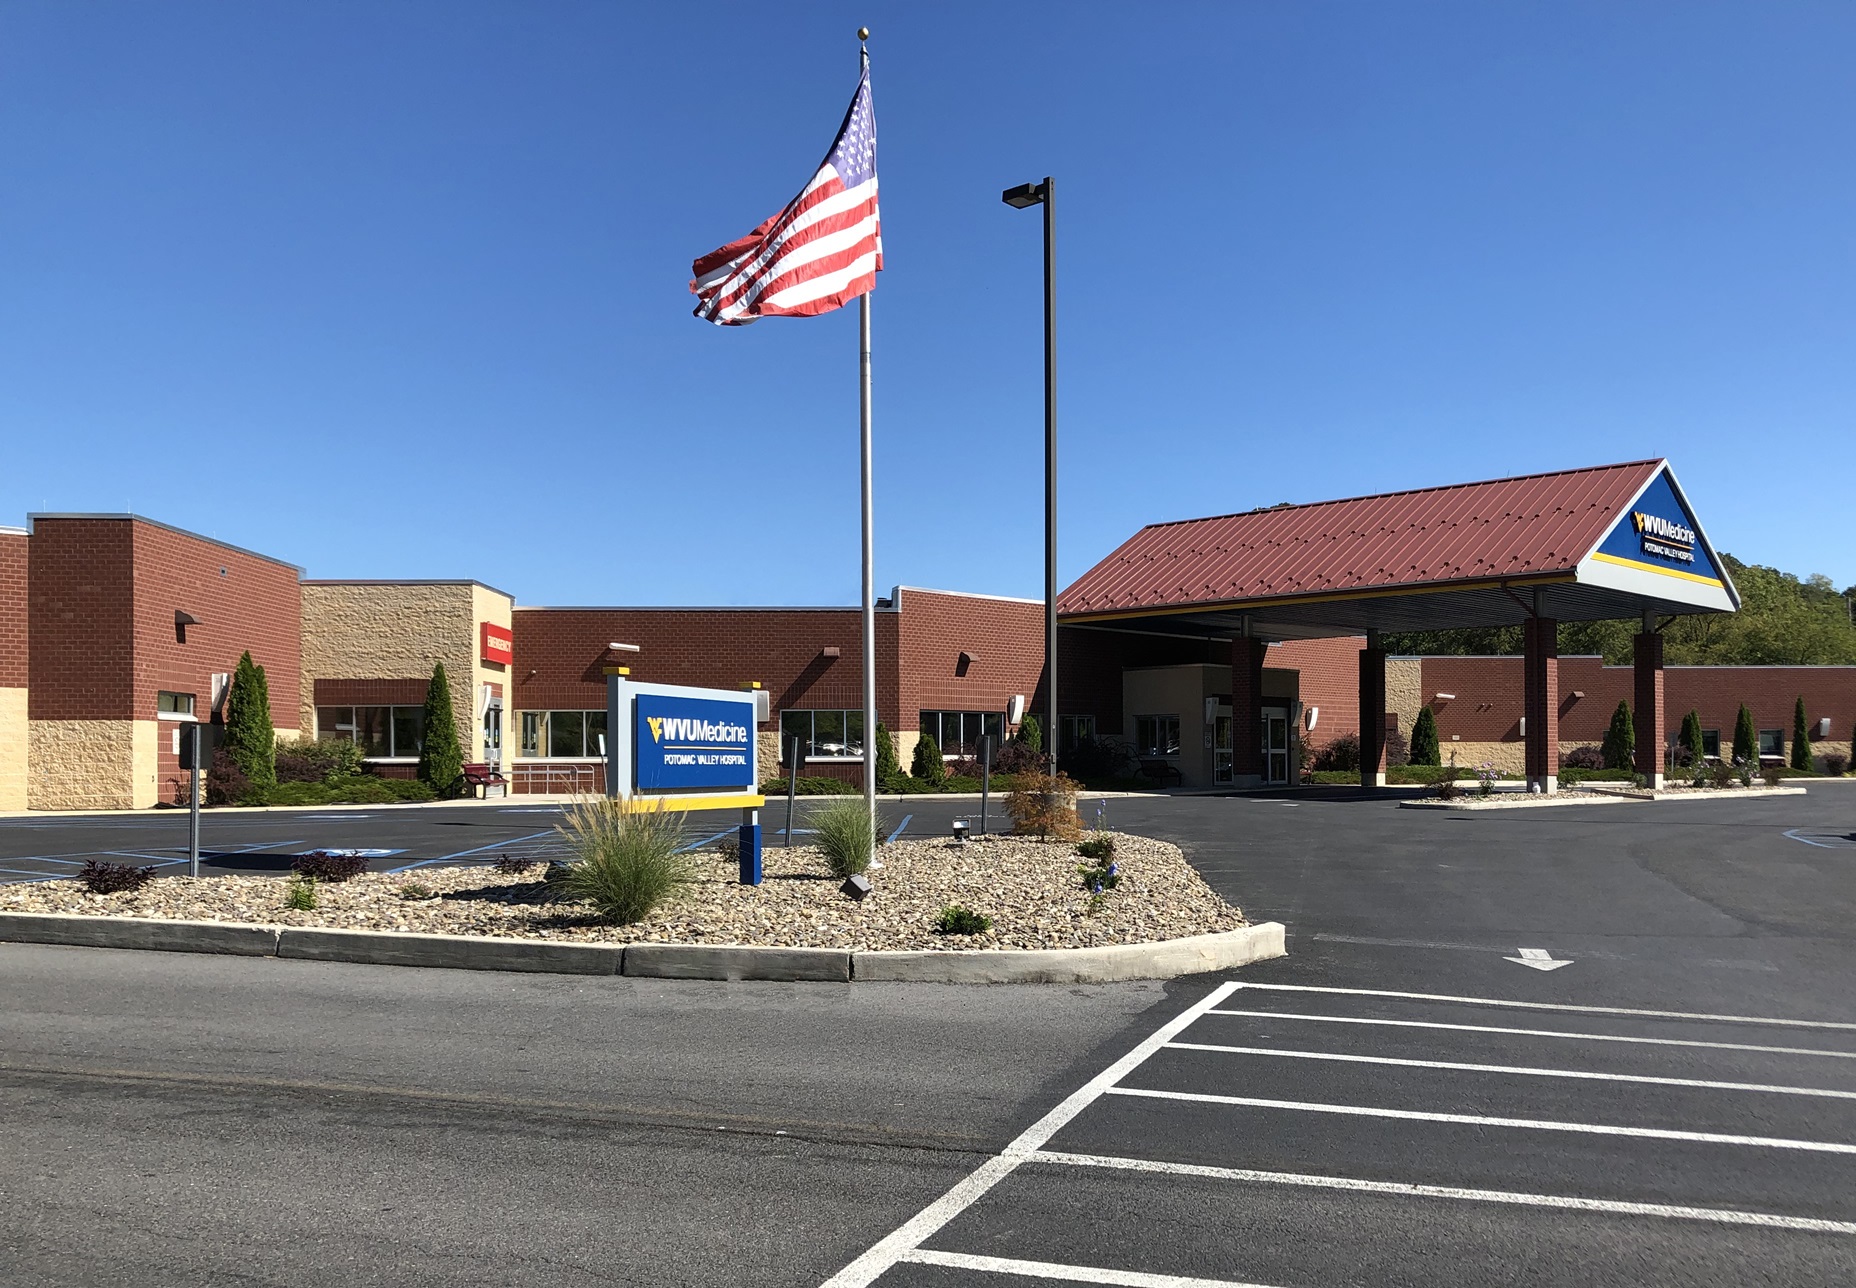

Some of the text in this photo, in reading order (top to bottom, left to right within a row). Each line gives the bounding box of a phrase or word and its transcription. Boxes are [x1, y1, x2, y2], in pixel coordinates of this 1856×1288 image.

[1645, 542, 1695, 562] POTOMAC VALLEY HOSPITAL
[487, 635, 511, 653] EMERGENCY
[664, 754, 747, 765] POTOMAC VALLEY HOSPITAL
